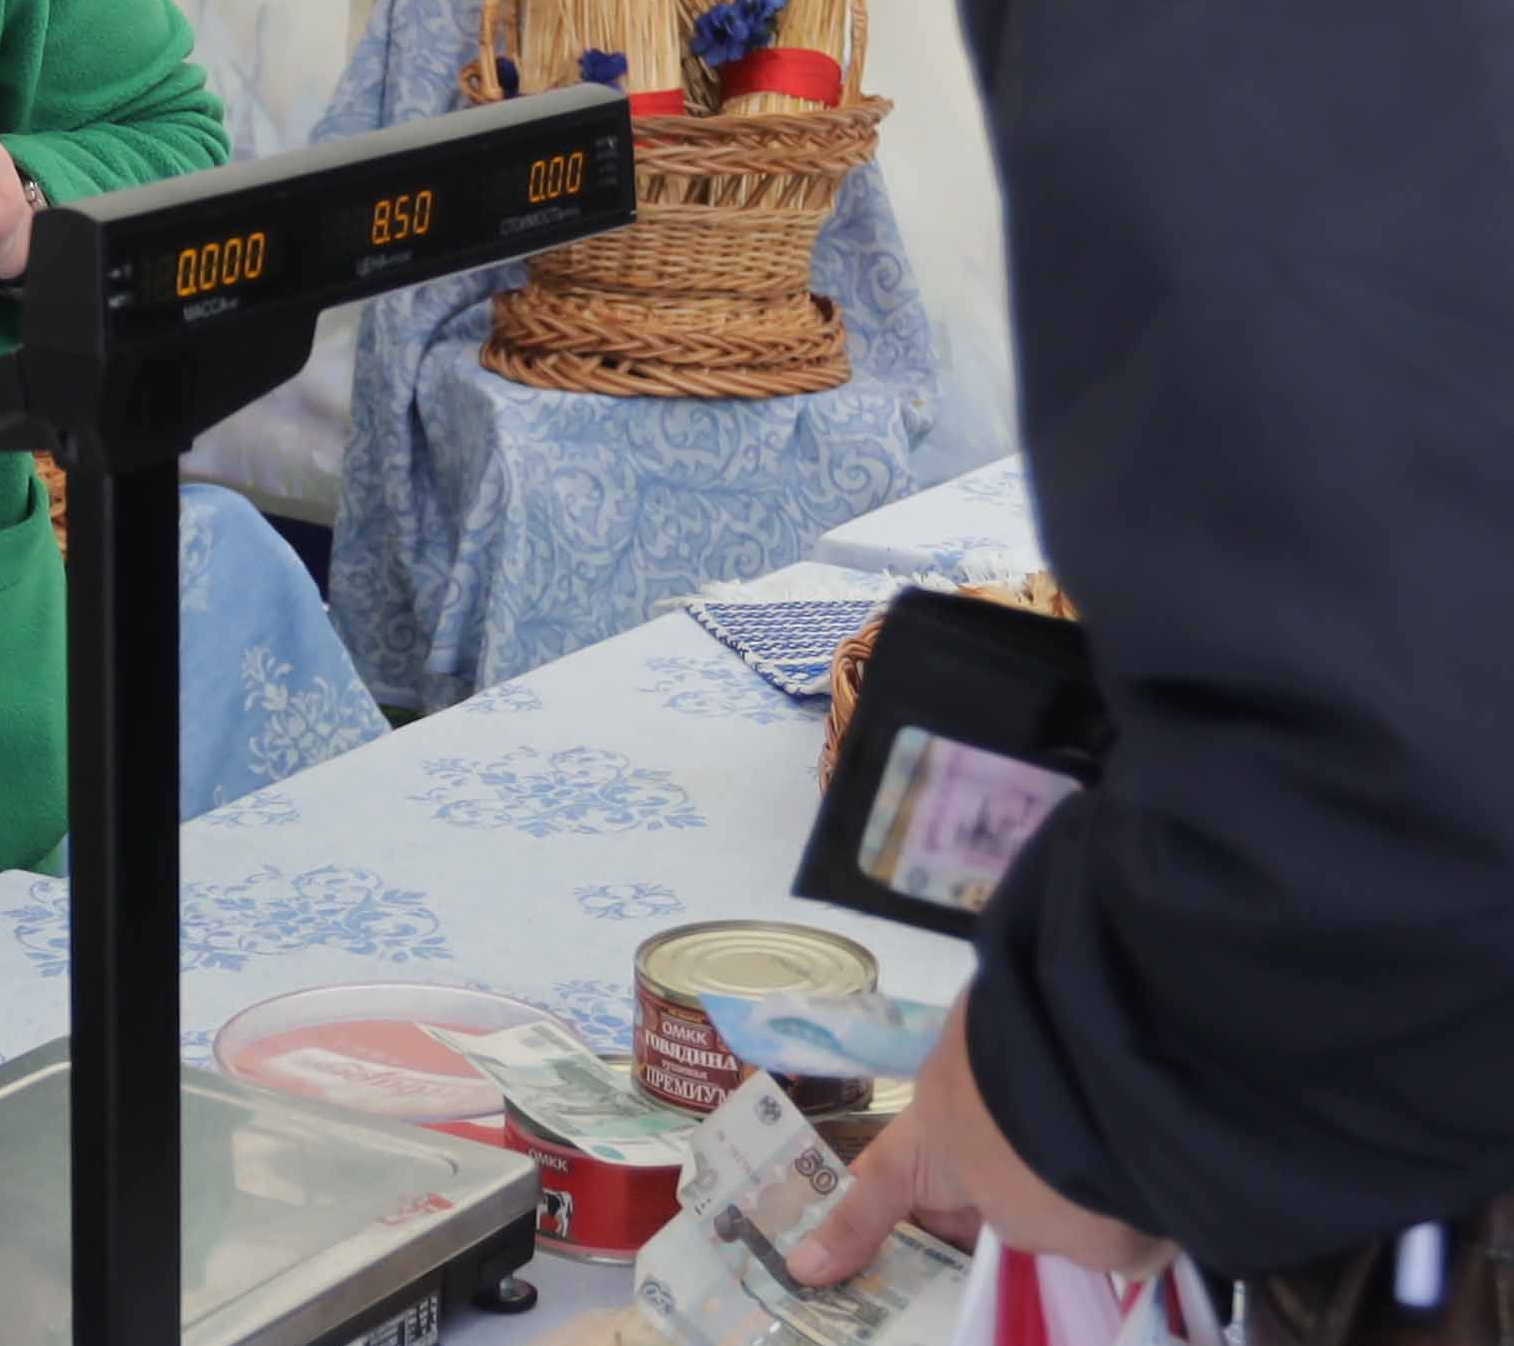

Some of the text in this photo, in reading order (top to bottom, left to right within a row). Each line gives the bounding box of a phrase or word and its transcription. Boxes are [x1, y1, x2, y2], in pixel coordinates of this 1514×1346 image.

[645, 1031, 739, 1072] ГОВЯДИНА
[661, 1020, 709, 1047] ОМКК
[794, 1148, 838, 1196] 50
